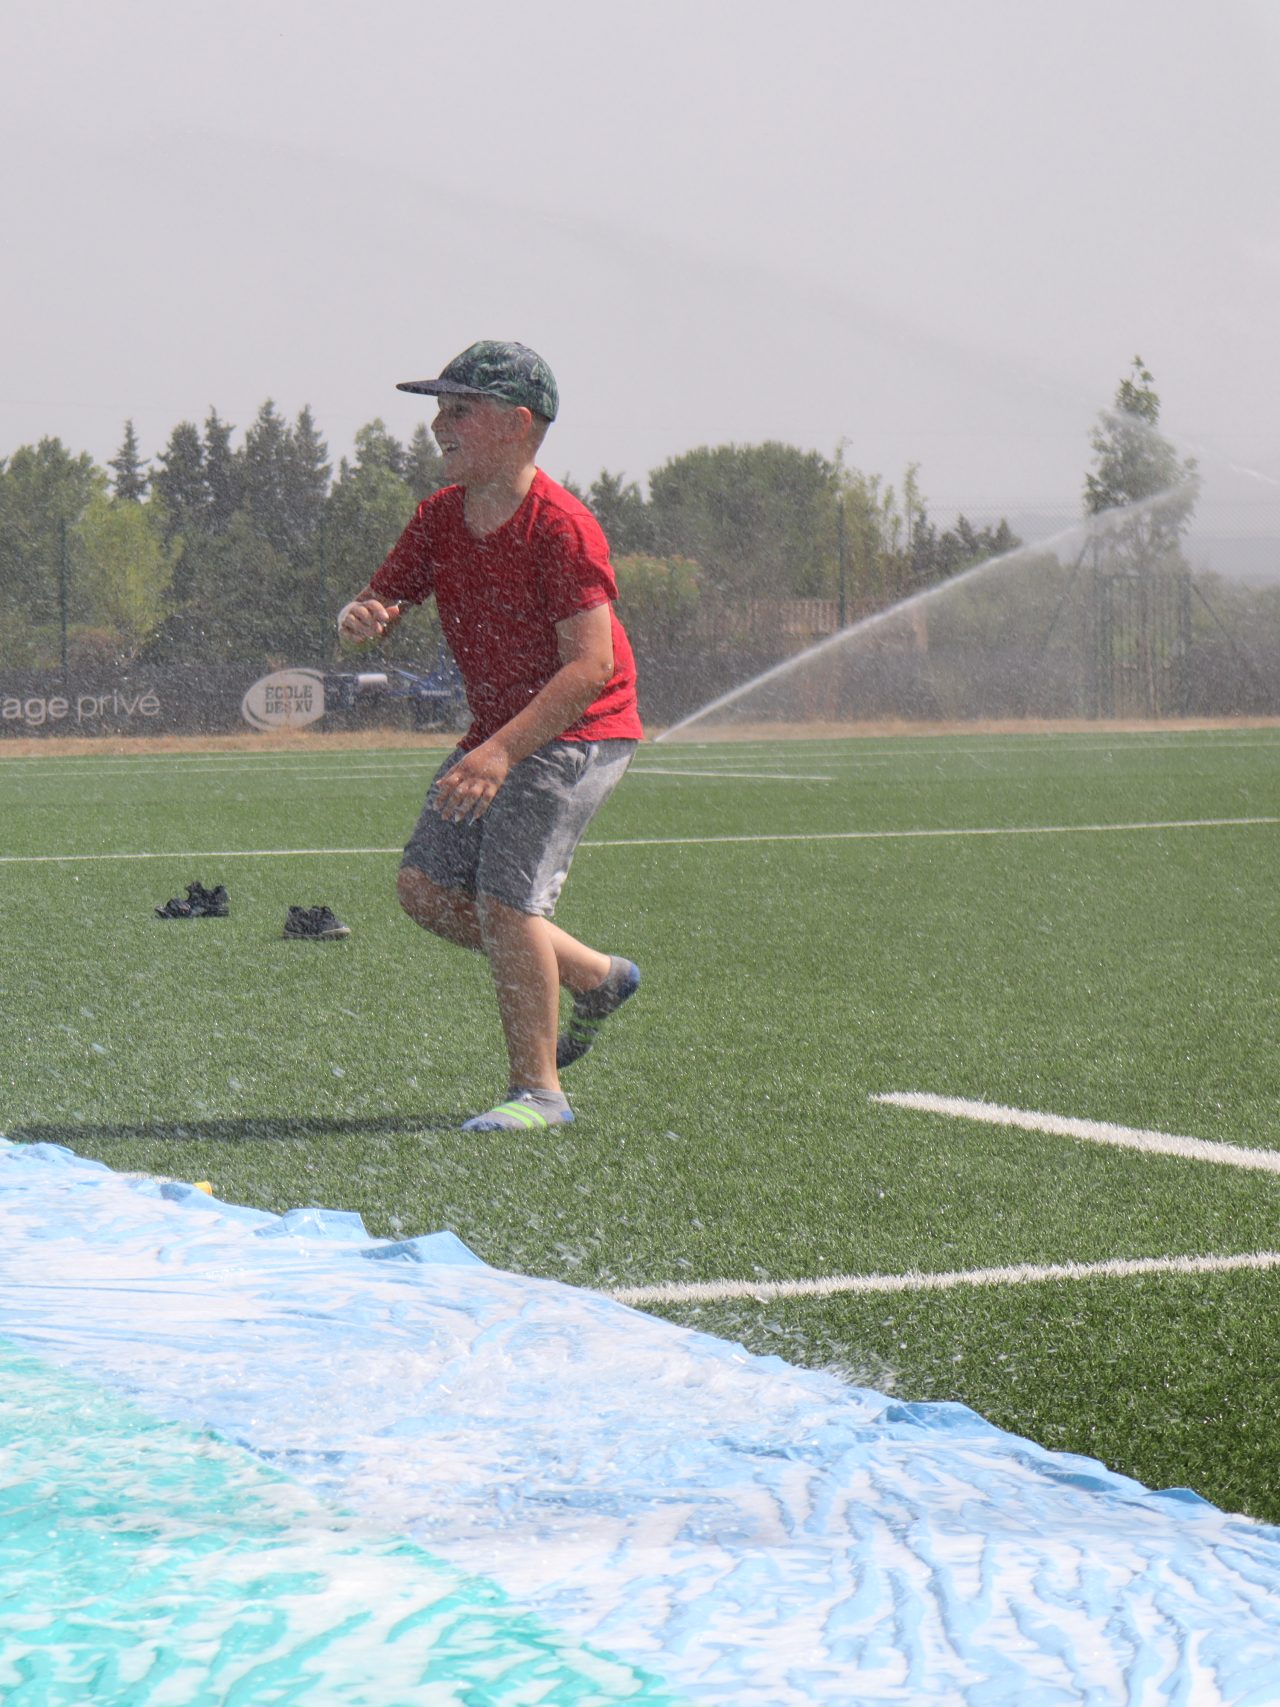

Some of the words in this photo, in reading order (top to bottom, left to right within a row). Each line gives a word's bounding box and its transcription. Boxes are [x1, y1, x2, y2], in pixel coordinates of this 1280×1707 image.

[78, 689, 160, 721] privé
[265, 701, 291, 714] DES
[295, 700, 313, 712] XV
